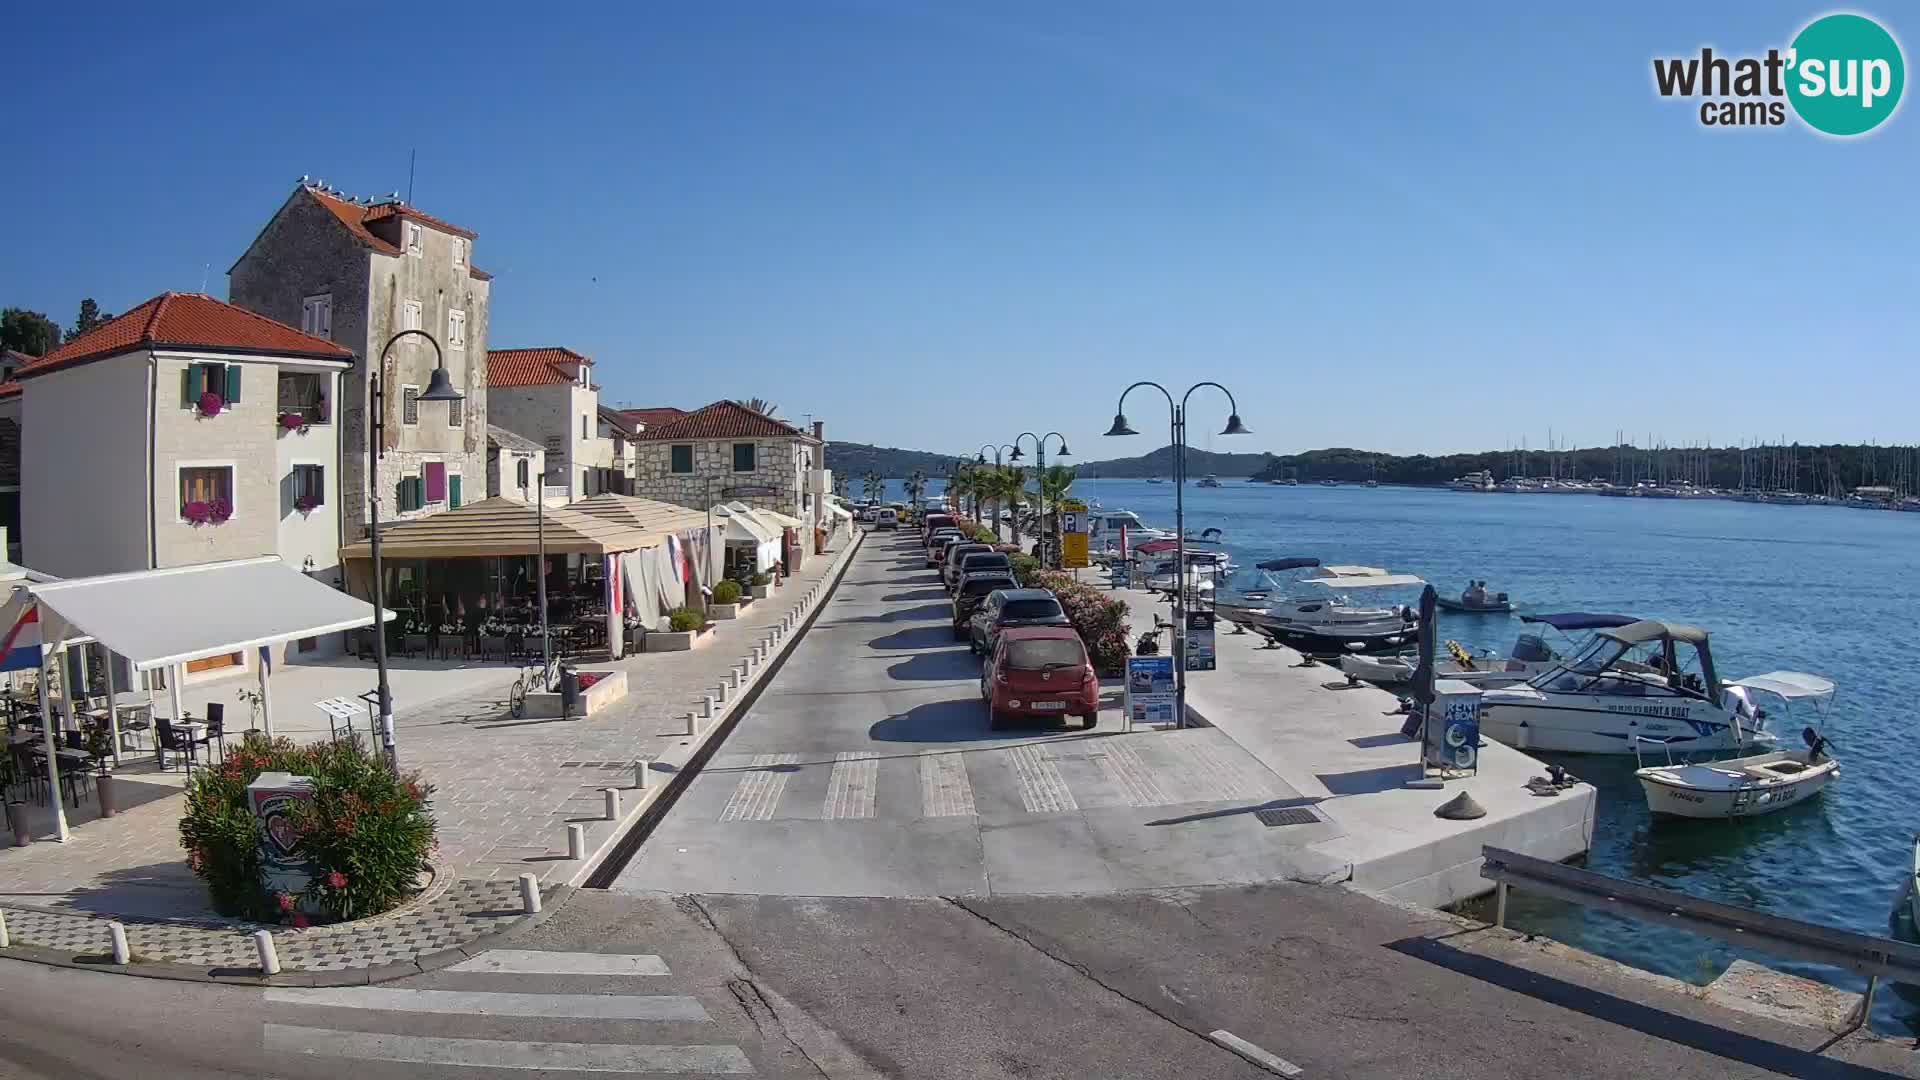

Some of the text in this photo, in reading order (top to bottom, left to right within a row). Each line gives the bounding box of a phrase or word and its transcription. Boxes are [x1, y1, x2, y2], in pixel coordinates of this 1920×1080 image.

[1065, 515, 1075, 530] P
[1447, 703, 1478, 712] RENT
[1643, 705, 1664, 715] RENT
[1671, 706, 1690, 719] BOAT
[1446, 712, 1453, 720] A
